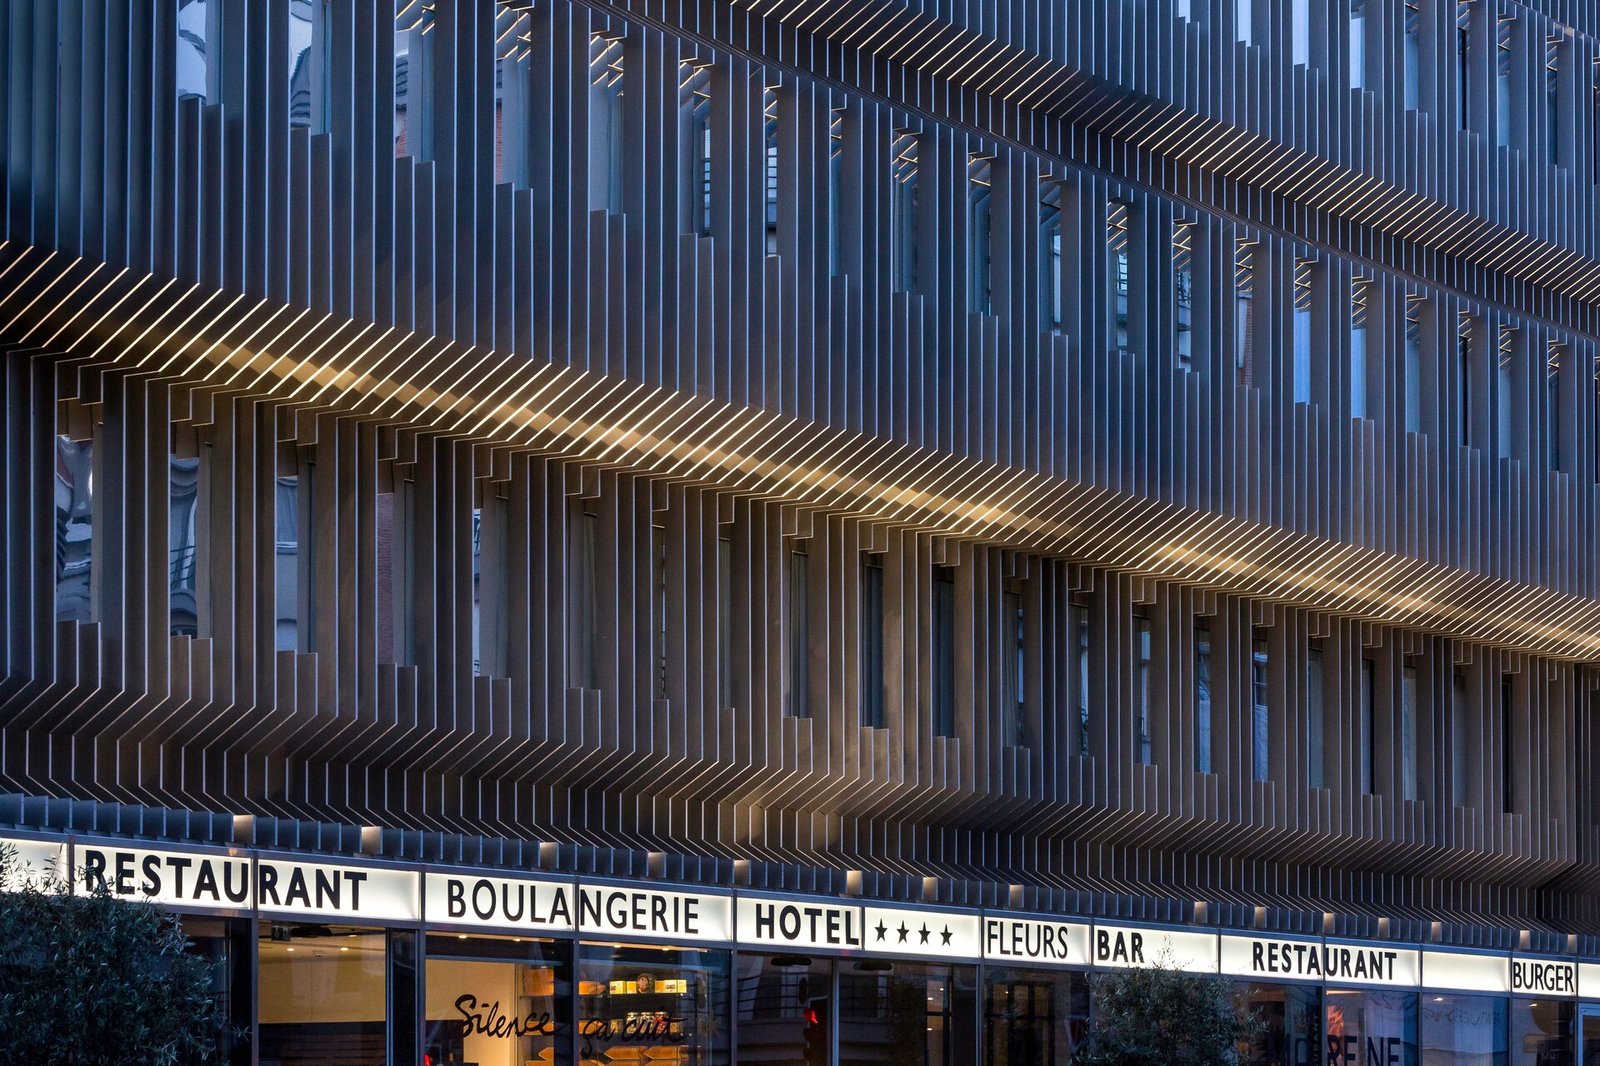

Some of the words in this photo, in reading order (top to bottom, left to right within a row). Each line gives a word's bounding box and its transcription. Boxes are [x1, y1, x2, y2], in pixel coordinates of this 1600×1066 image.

[85, 849, 368, 911] RESTAURANT
[447, 878, 699, 935] BOULANGERIE
[755, 903, 859, 946] HOTEL
[987, 920, 1068, 960] FLEURS
[1097, 929, 1145, 964] BAR
[1252, 941, 1397, 980] RESTAURANT
[1513, 961, 1574, 993] BURGER
[455, 993, 563, 1038] Silence
[621, 1008, 689, 1043] cuit
